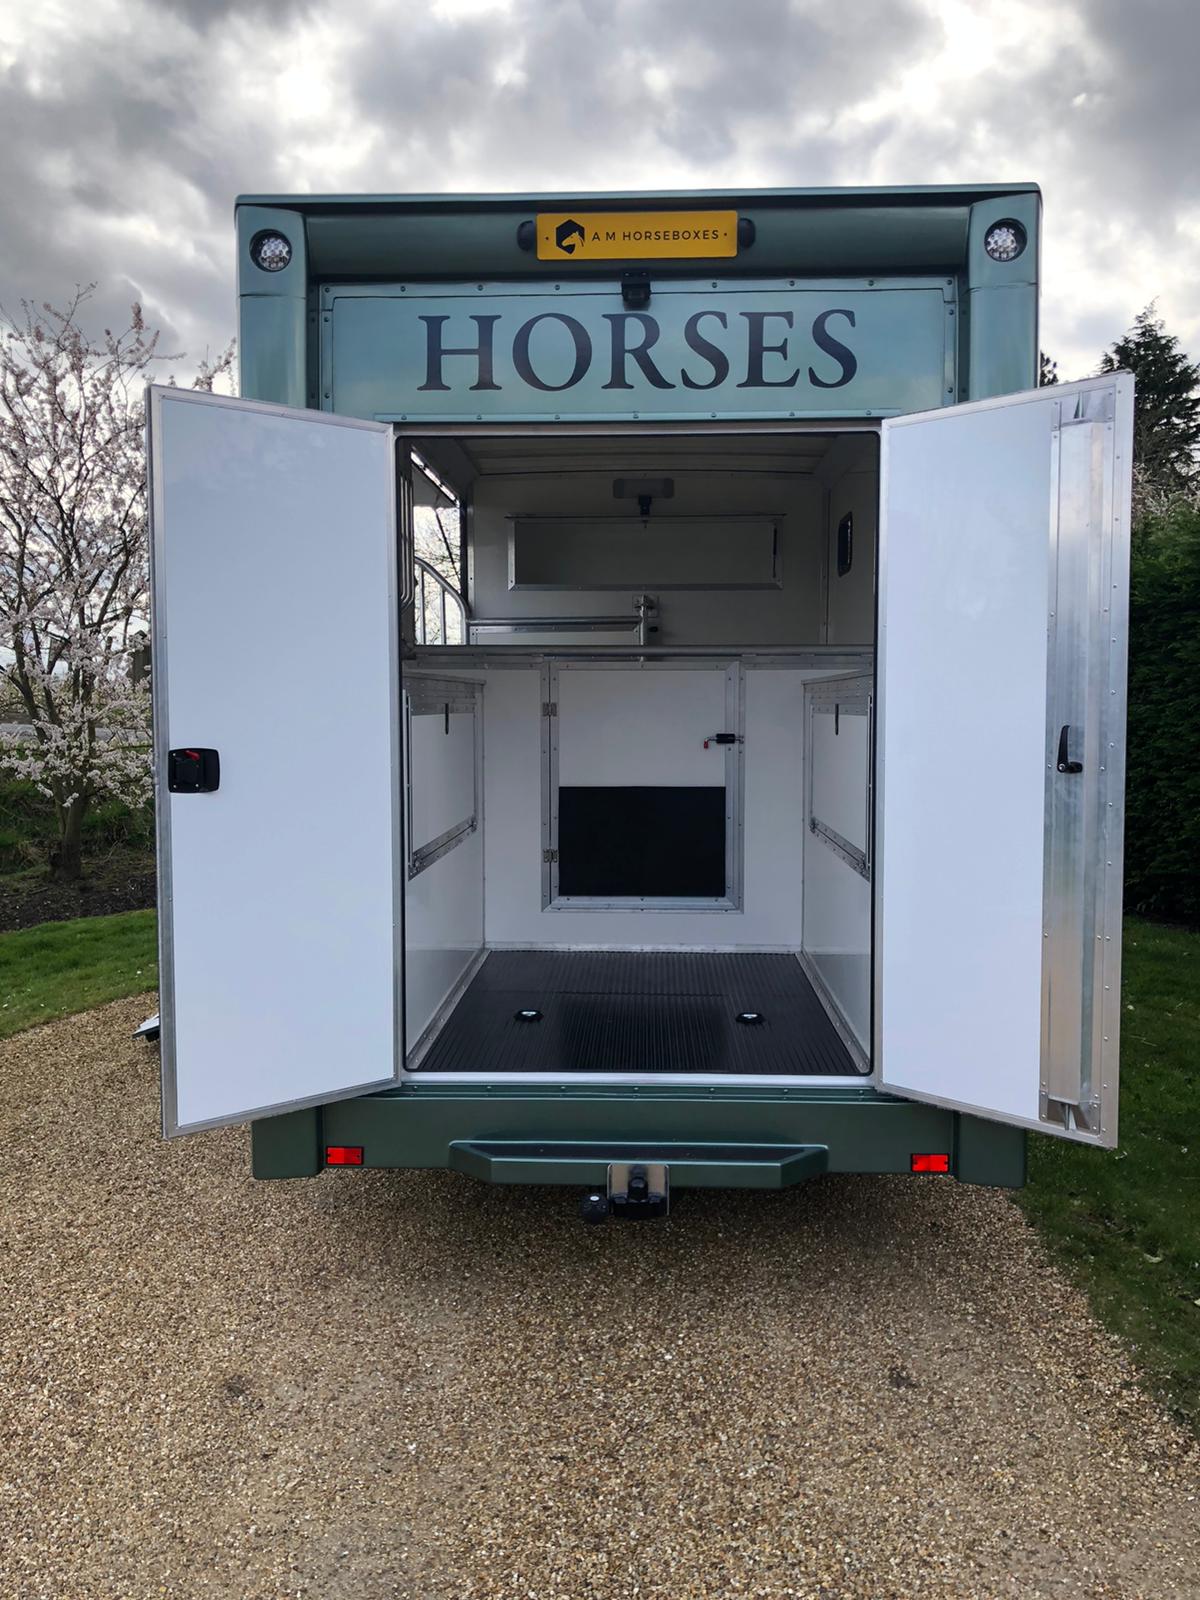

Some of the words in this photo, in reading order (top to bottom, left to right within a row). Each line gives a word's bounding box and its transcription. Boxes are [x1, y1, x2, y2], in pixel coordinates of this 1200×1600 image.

[591, 232, 601, 241] A
[605, 231, 616, 241] M
[622, 229, 719, 241] HORSEBOXES
[417, 309, 858, 391] HORSES
